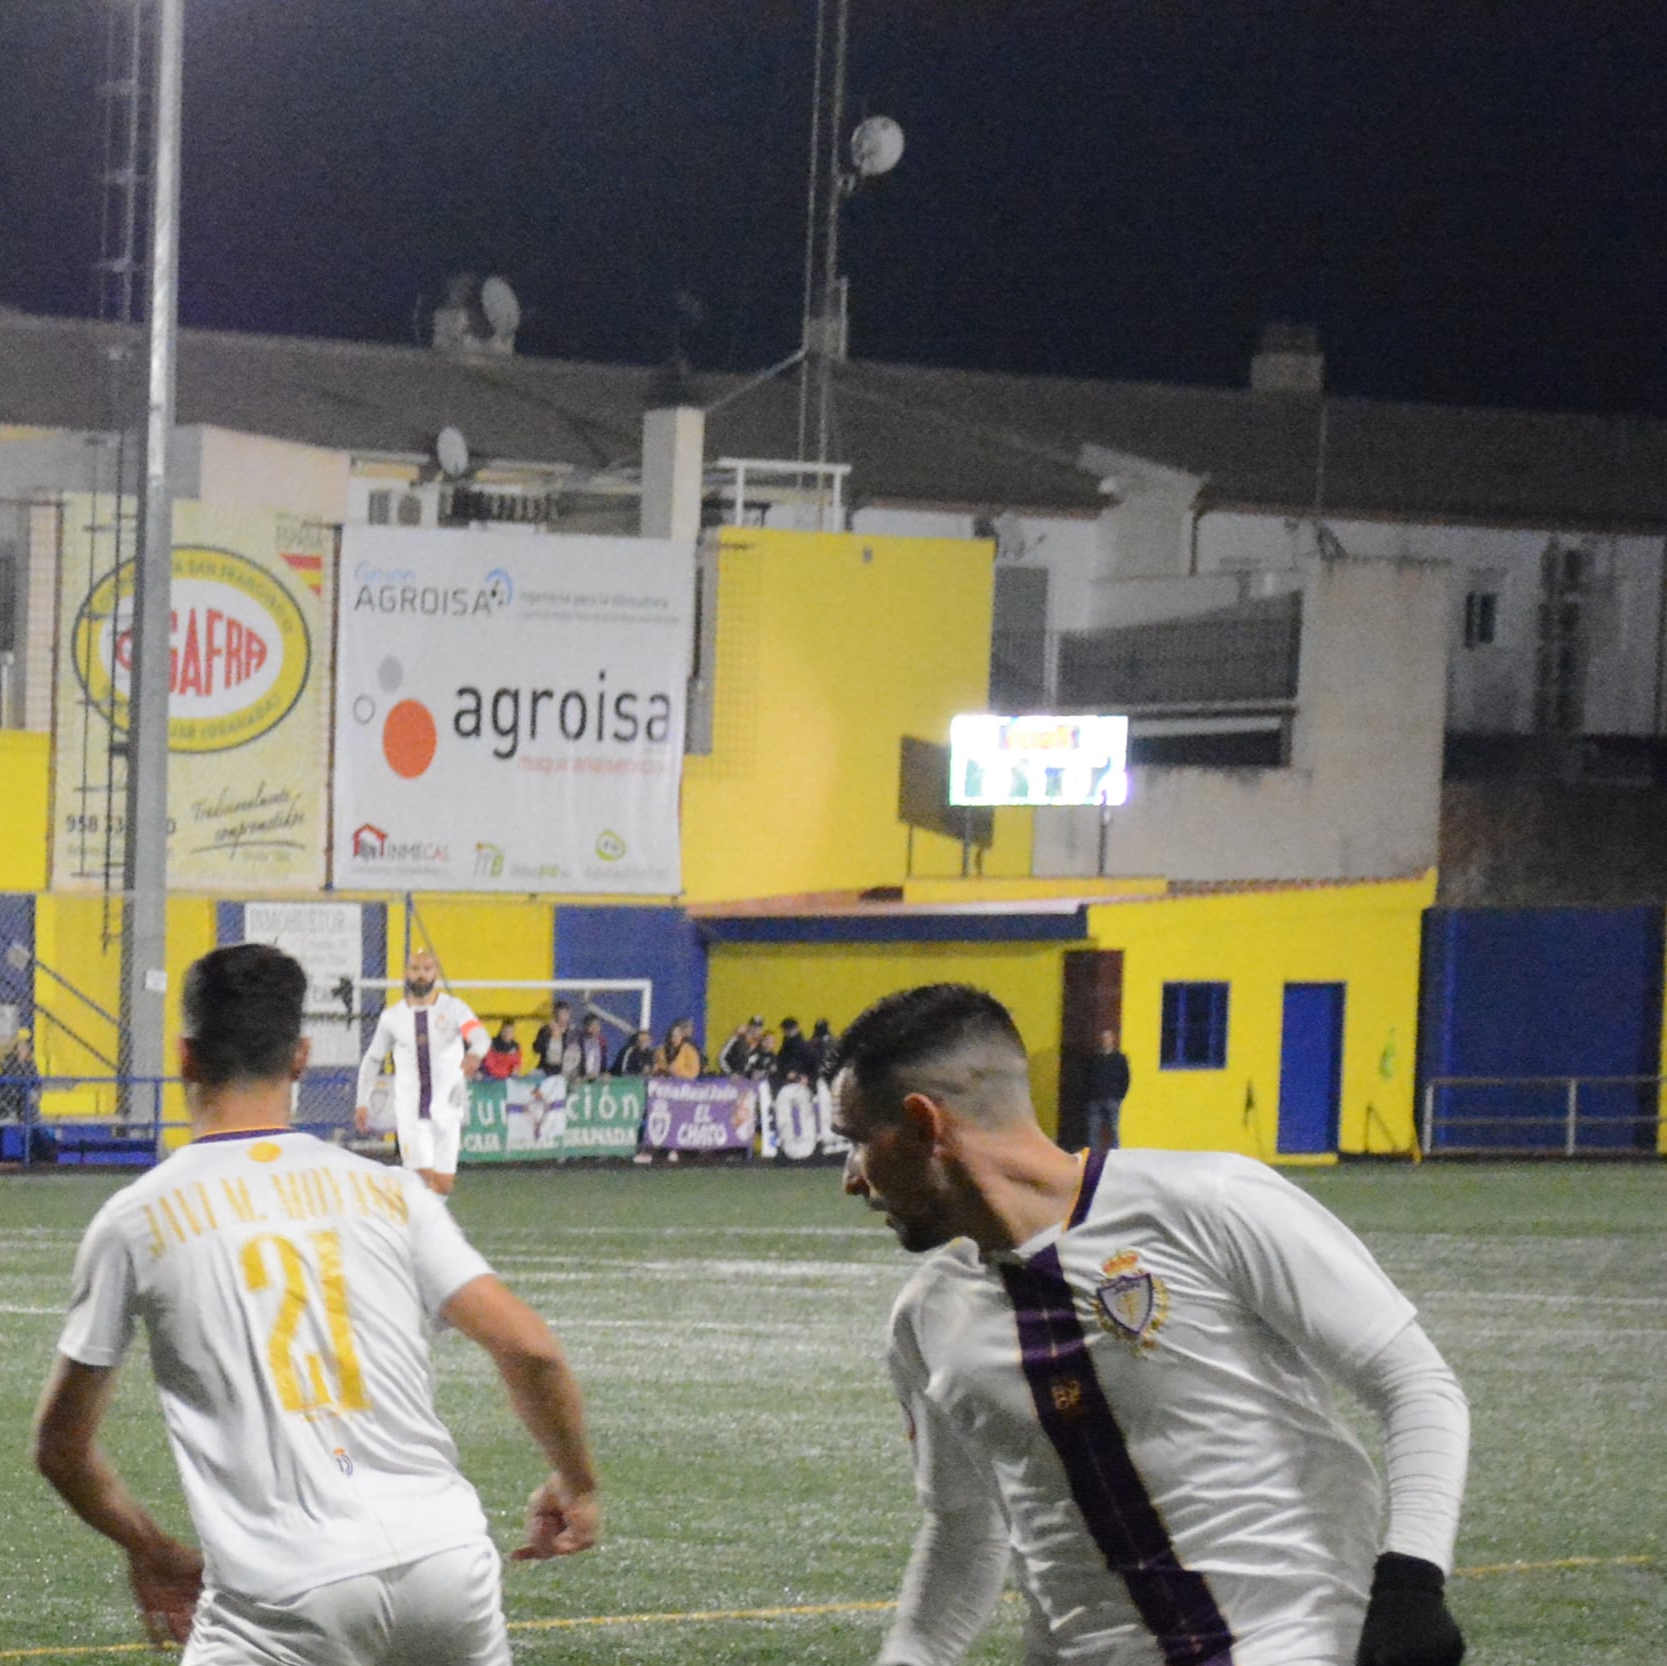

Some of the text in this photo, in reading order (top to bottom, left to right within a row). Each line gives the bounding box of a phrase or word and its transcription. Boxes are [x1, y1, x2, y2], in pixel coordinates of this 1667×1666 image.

[353, 584, 493, 617] AGROISA
[453, 669, 671, 761] agroisa
[693, 1104, 713, 1123] EL
[238, 1226, 373, 1413] 21
